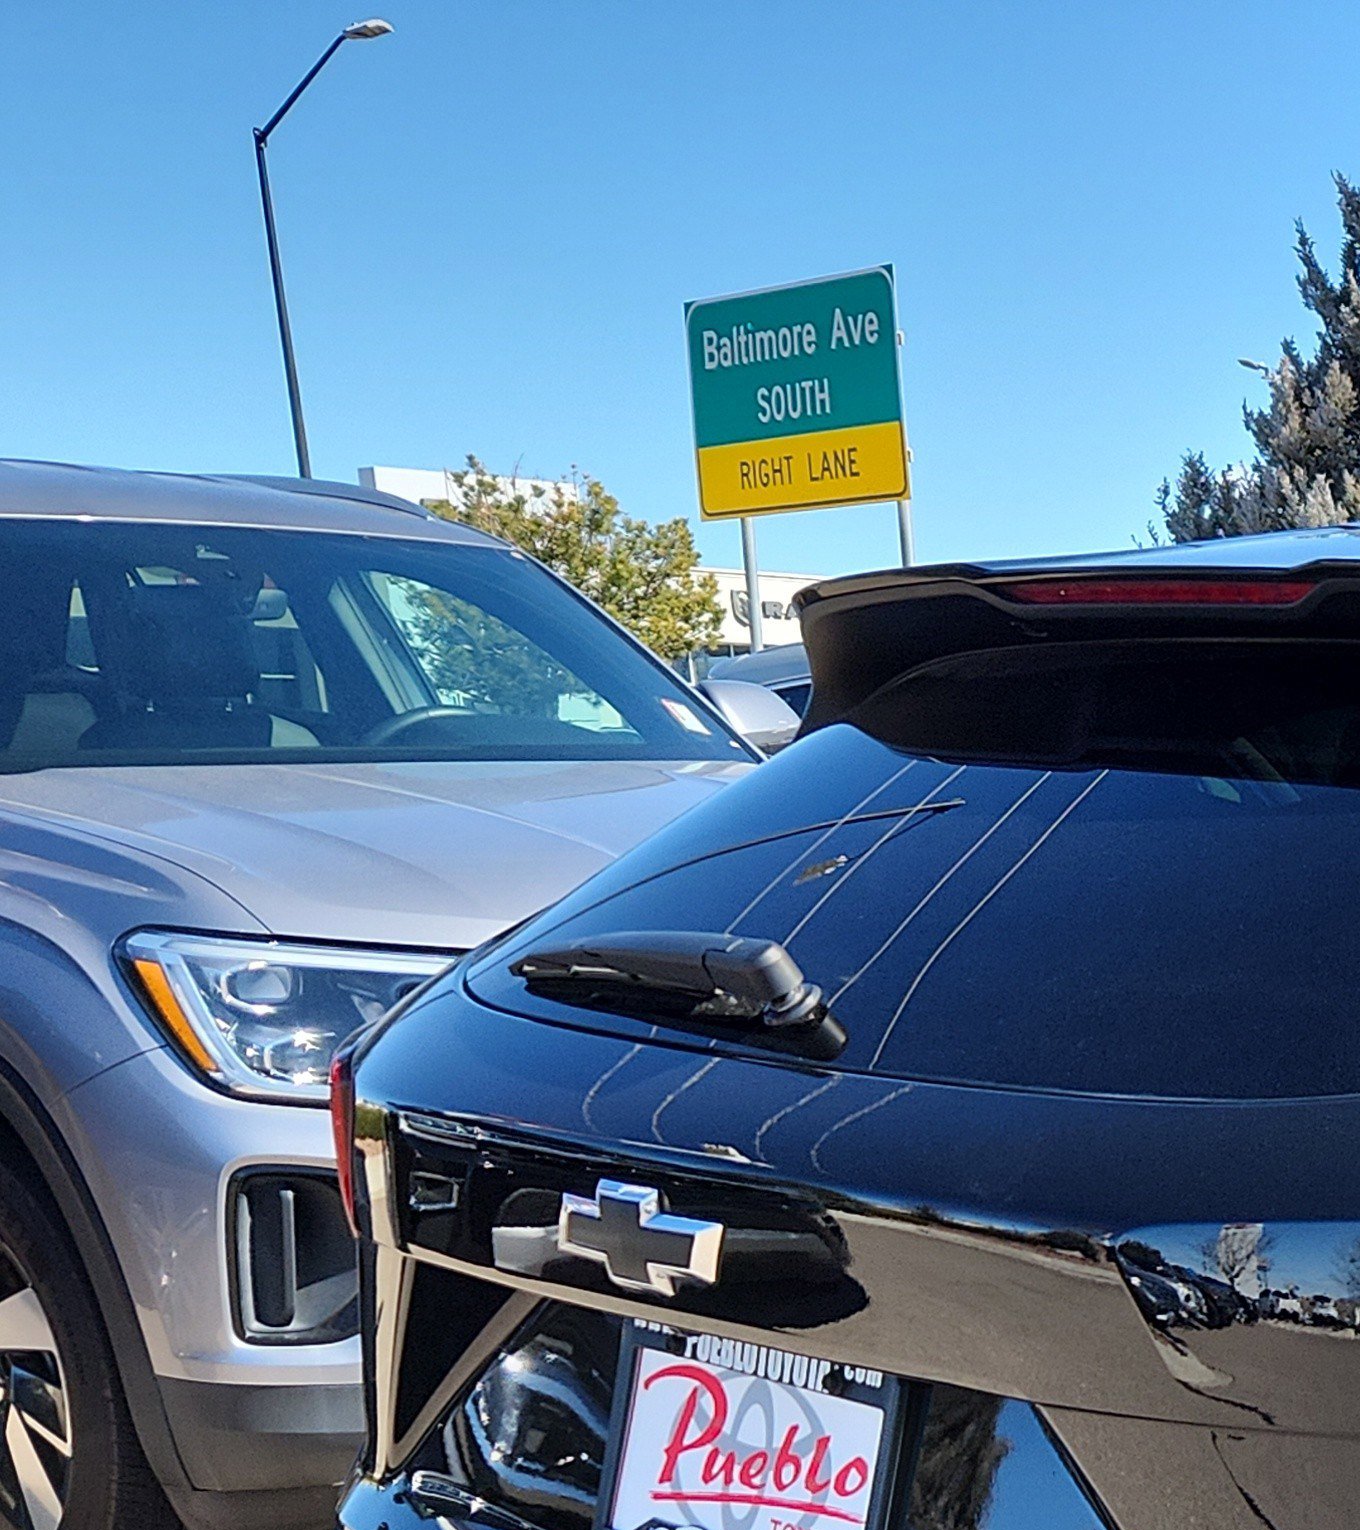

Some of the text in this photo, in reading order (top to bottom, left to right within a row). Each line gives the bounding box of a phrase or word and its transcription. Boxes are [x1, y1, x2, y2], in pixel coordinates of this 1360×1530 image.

[702, 308, 879, 370] Baltimore Ave
[757, 378, 831, 423] SOUTH
[739, 447, 860, 489] RIGHT LANE
[761, 600, 798, 620] RA
[643, 1364, 869, 1497] Pueblo
